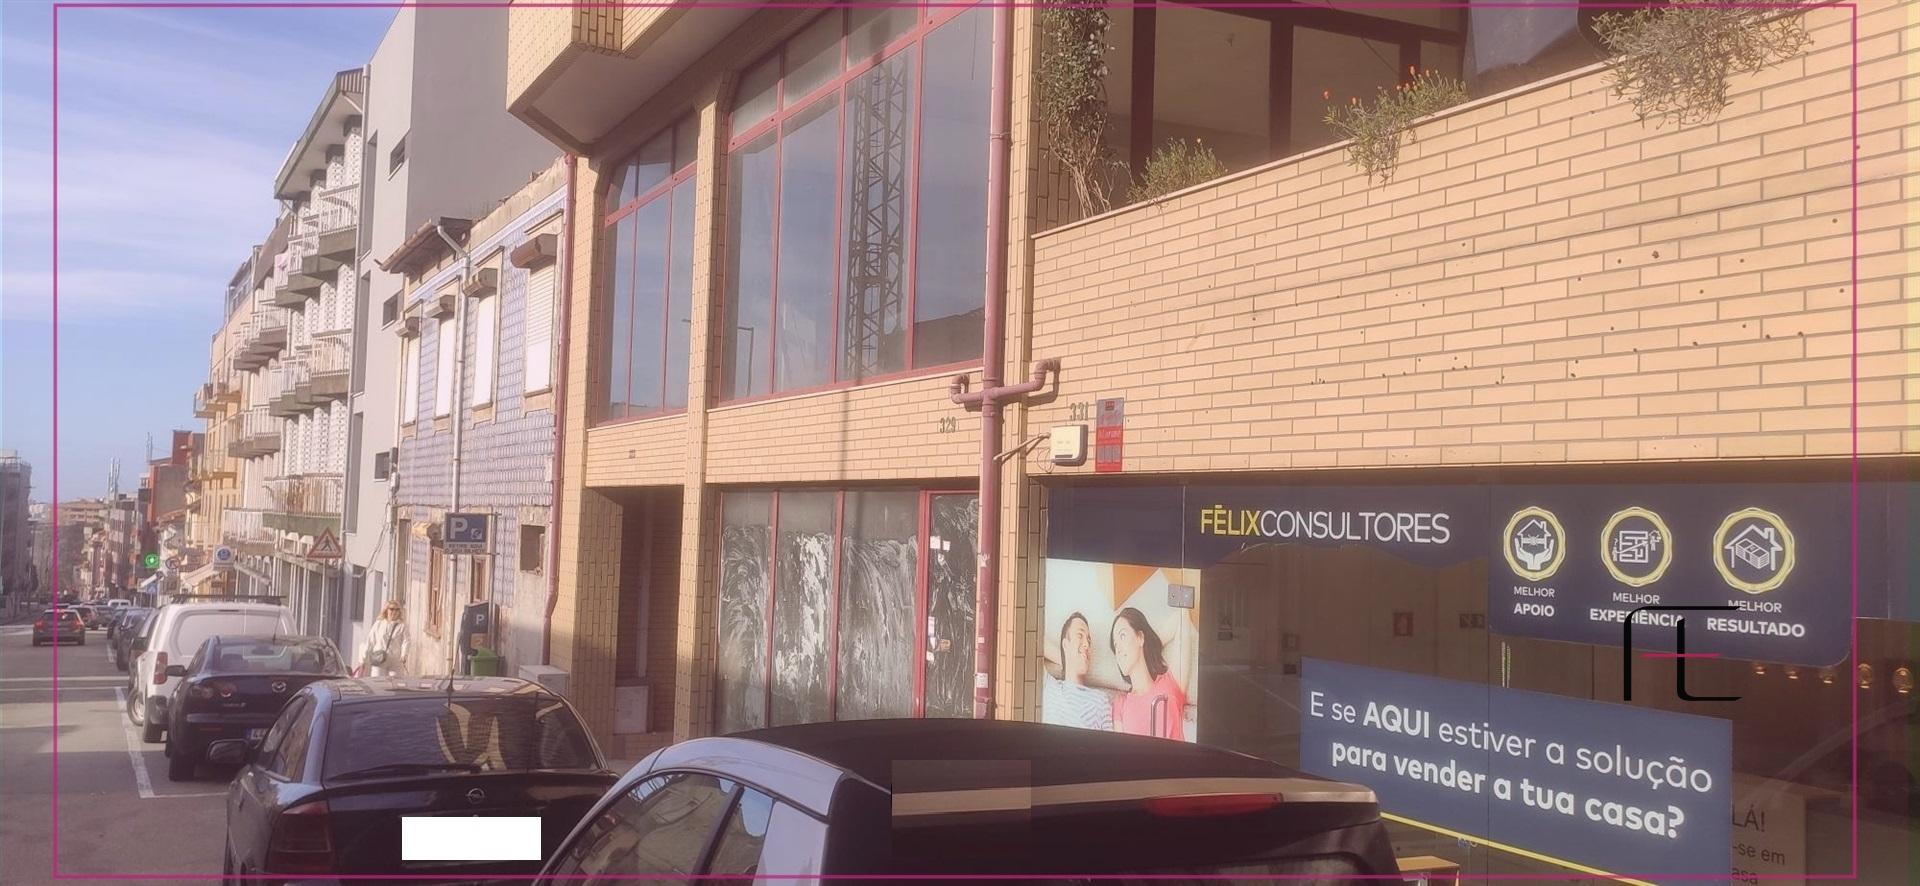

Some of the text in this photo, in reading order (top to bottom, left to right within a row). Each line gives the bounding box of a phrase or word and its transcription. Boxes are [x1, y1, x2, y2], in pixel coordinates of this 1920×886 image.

[1070, 401, 1088, 421] 331
[940, 416, 956, 434] 329
[450, 517, 468, 539] P
[1513, 586, 1555, 598] MELHOR
[1612, 591, 1660, 605] MELHOR
[1513, 603, 1555, 617] APOIO
[1728, 599, 1782, 614] MELHOR
[476, 614, 485, 624] P
[1589, 608, 1685, 628] EXPEIÊNCIA
[1707, 617, 1805, 638] RESULTADO
[1310, 691, 1713, 792] E se AQUI estiver a solução
[1332, 742, 1685, 839] para vender a tua casa?
[1732, 804, 1765, 832] LÁ!
[1760, 848, 1785, 866] em
